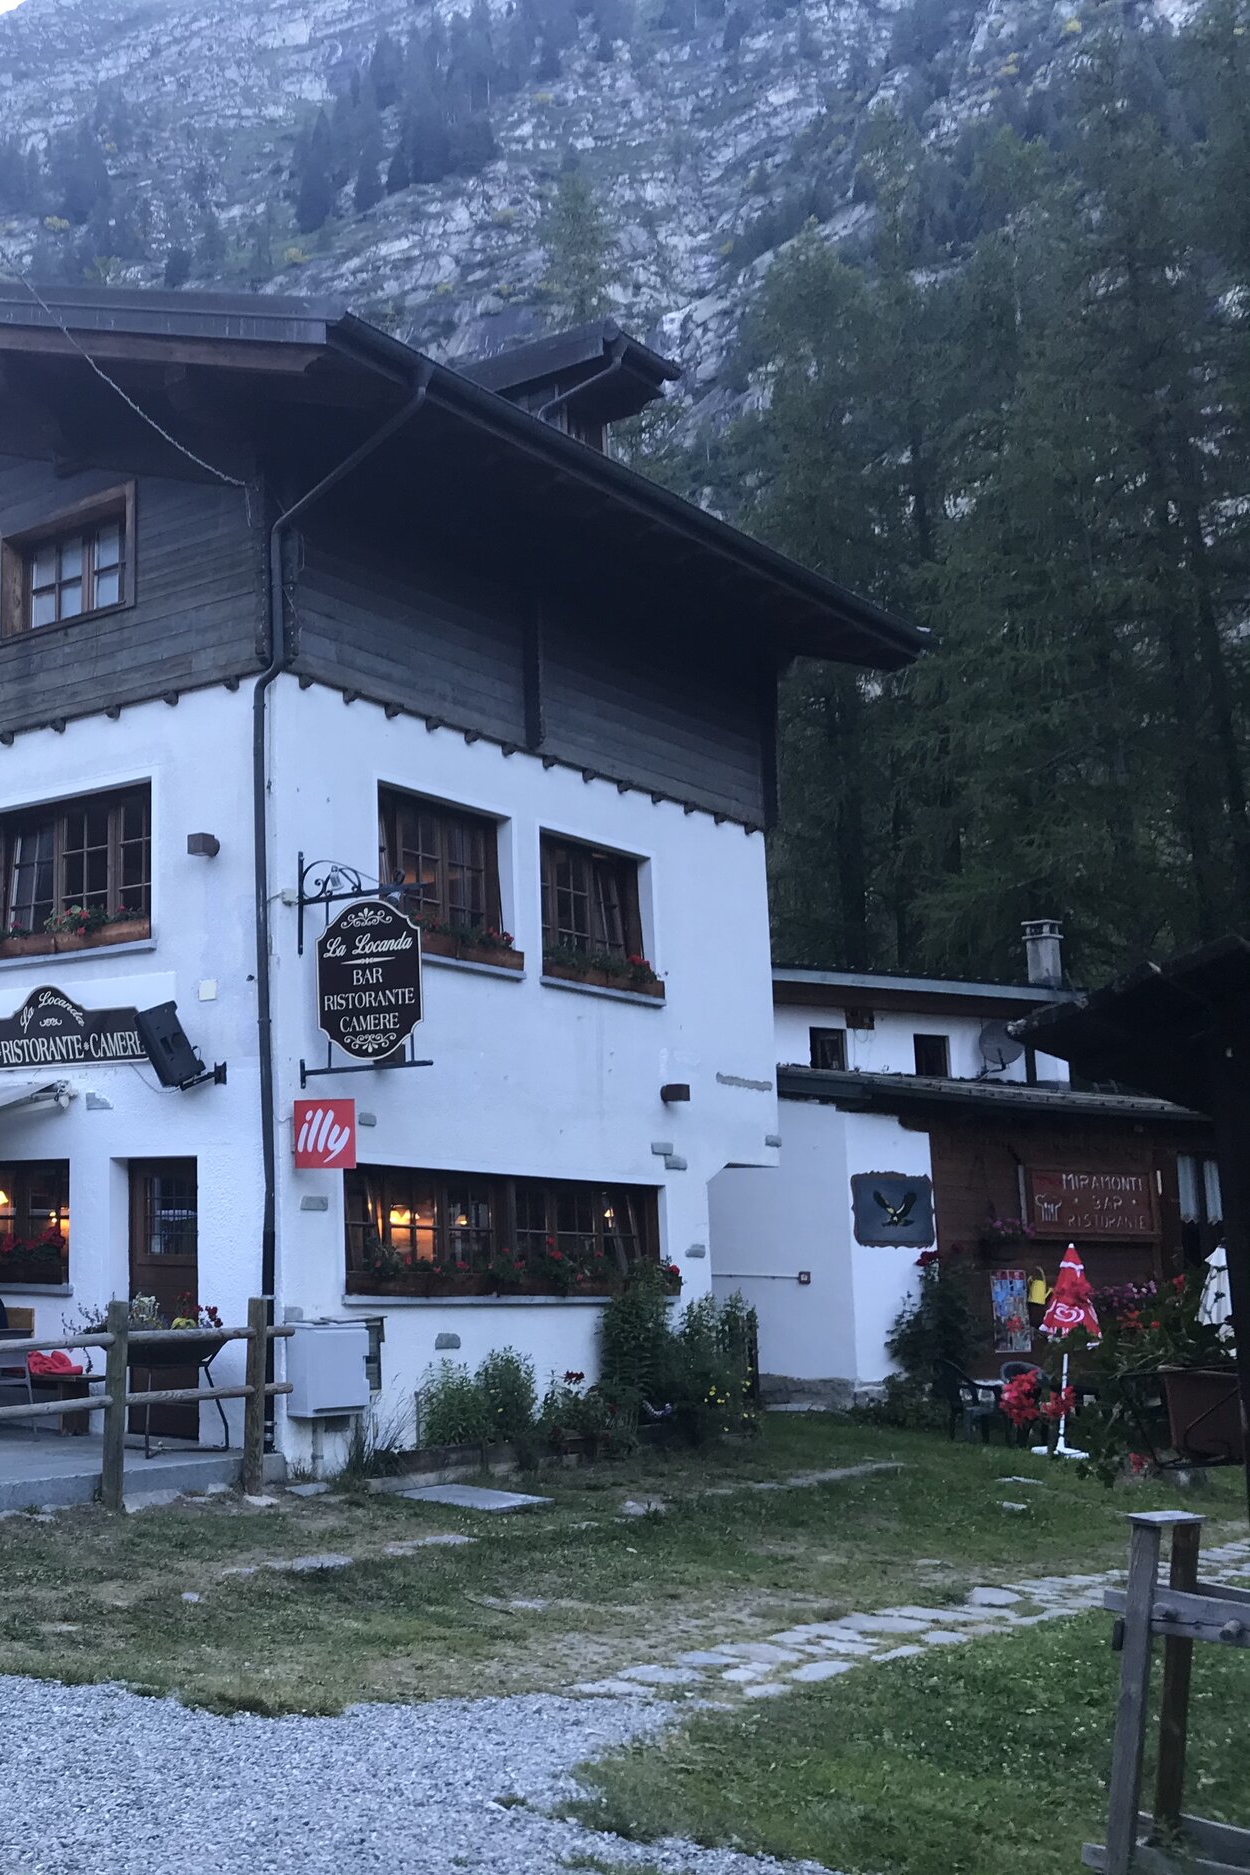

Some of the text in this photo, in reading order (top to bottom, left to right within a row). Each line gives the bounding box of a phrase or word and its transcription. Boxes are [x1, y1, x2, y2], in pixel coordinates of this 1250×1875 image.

[323, 931, 413, 959] La Locanda
[353, 967, 383, 986] BAR
[19, 990, 85, 1034] La Locanda
[323, 988, 416, 1012] RISTORANTE
[339, 1013, 400, 1034] CAMERE
[0, 1035, 84, 1065] RISTORANTE
[297, 1108, 350, 1164] illy
